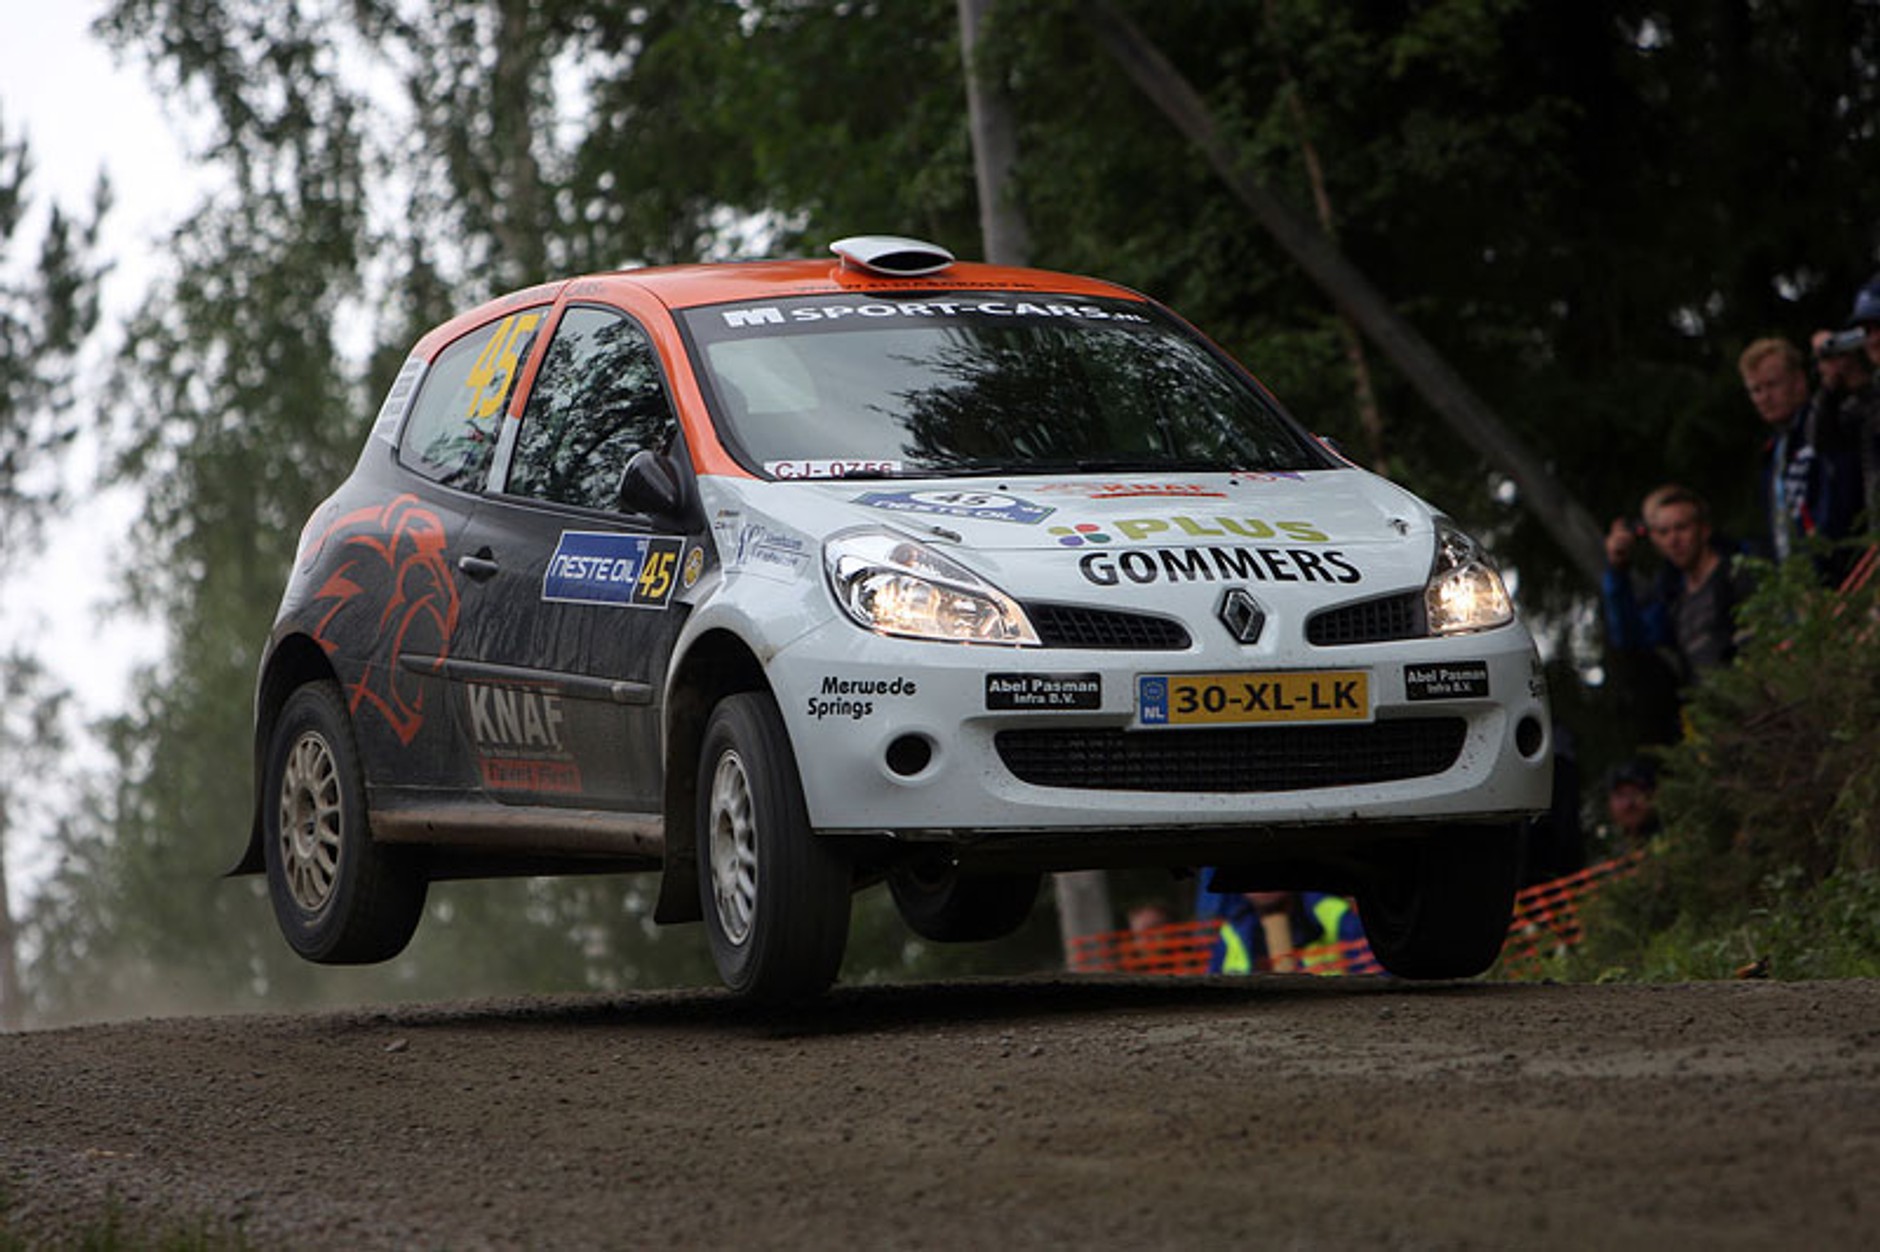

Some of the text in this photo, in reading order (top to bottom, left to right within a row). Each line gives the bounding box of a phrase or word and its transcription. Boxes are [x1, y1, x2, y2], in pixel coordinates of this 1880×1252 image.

[465, 314, 541, 418] 45
[1114, 517, 1330, 542] PLUS
[639, 552, 676, 598] 45
[1079, 547, 1362, 586] GOMMERS
[821, 677, 917, 696] Merwede
[989, 679, 1099, 692] Abel Pasman
[1175, 680, 1359, 714] 30-XL-LK
[807, 697, 873, 720] Springs
[1014, 693, 1046, 704] Infra
[467, 683, 562, 746] KNAF
[1143, 706, 1166, 720] NL
